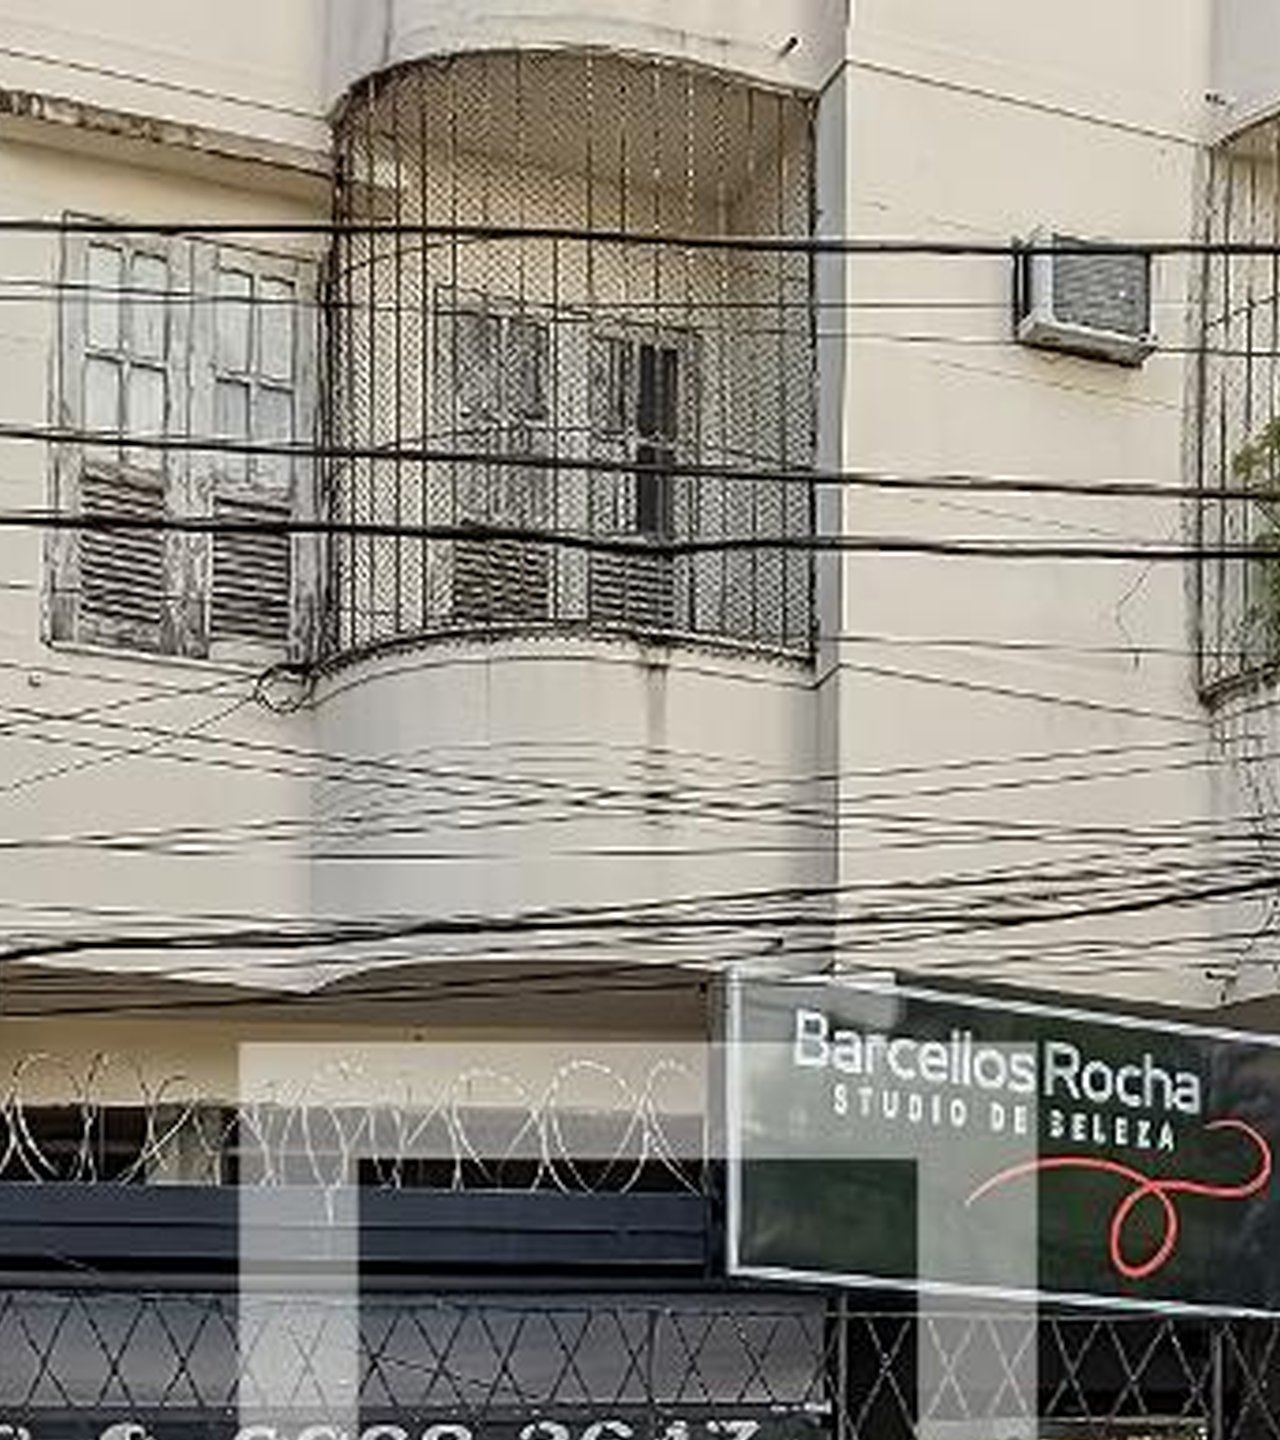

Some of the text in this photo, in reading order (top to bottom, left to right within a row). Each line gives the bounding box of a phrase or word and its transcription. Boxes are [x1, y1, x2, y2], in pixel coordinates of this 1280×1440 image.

[794, 1008, 1200, 1115] Barcellos Rocha
[833, 1083, 1175, 1151] STUDIO DE BELEZA
